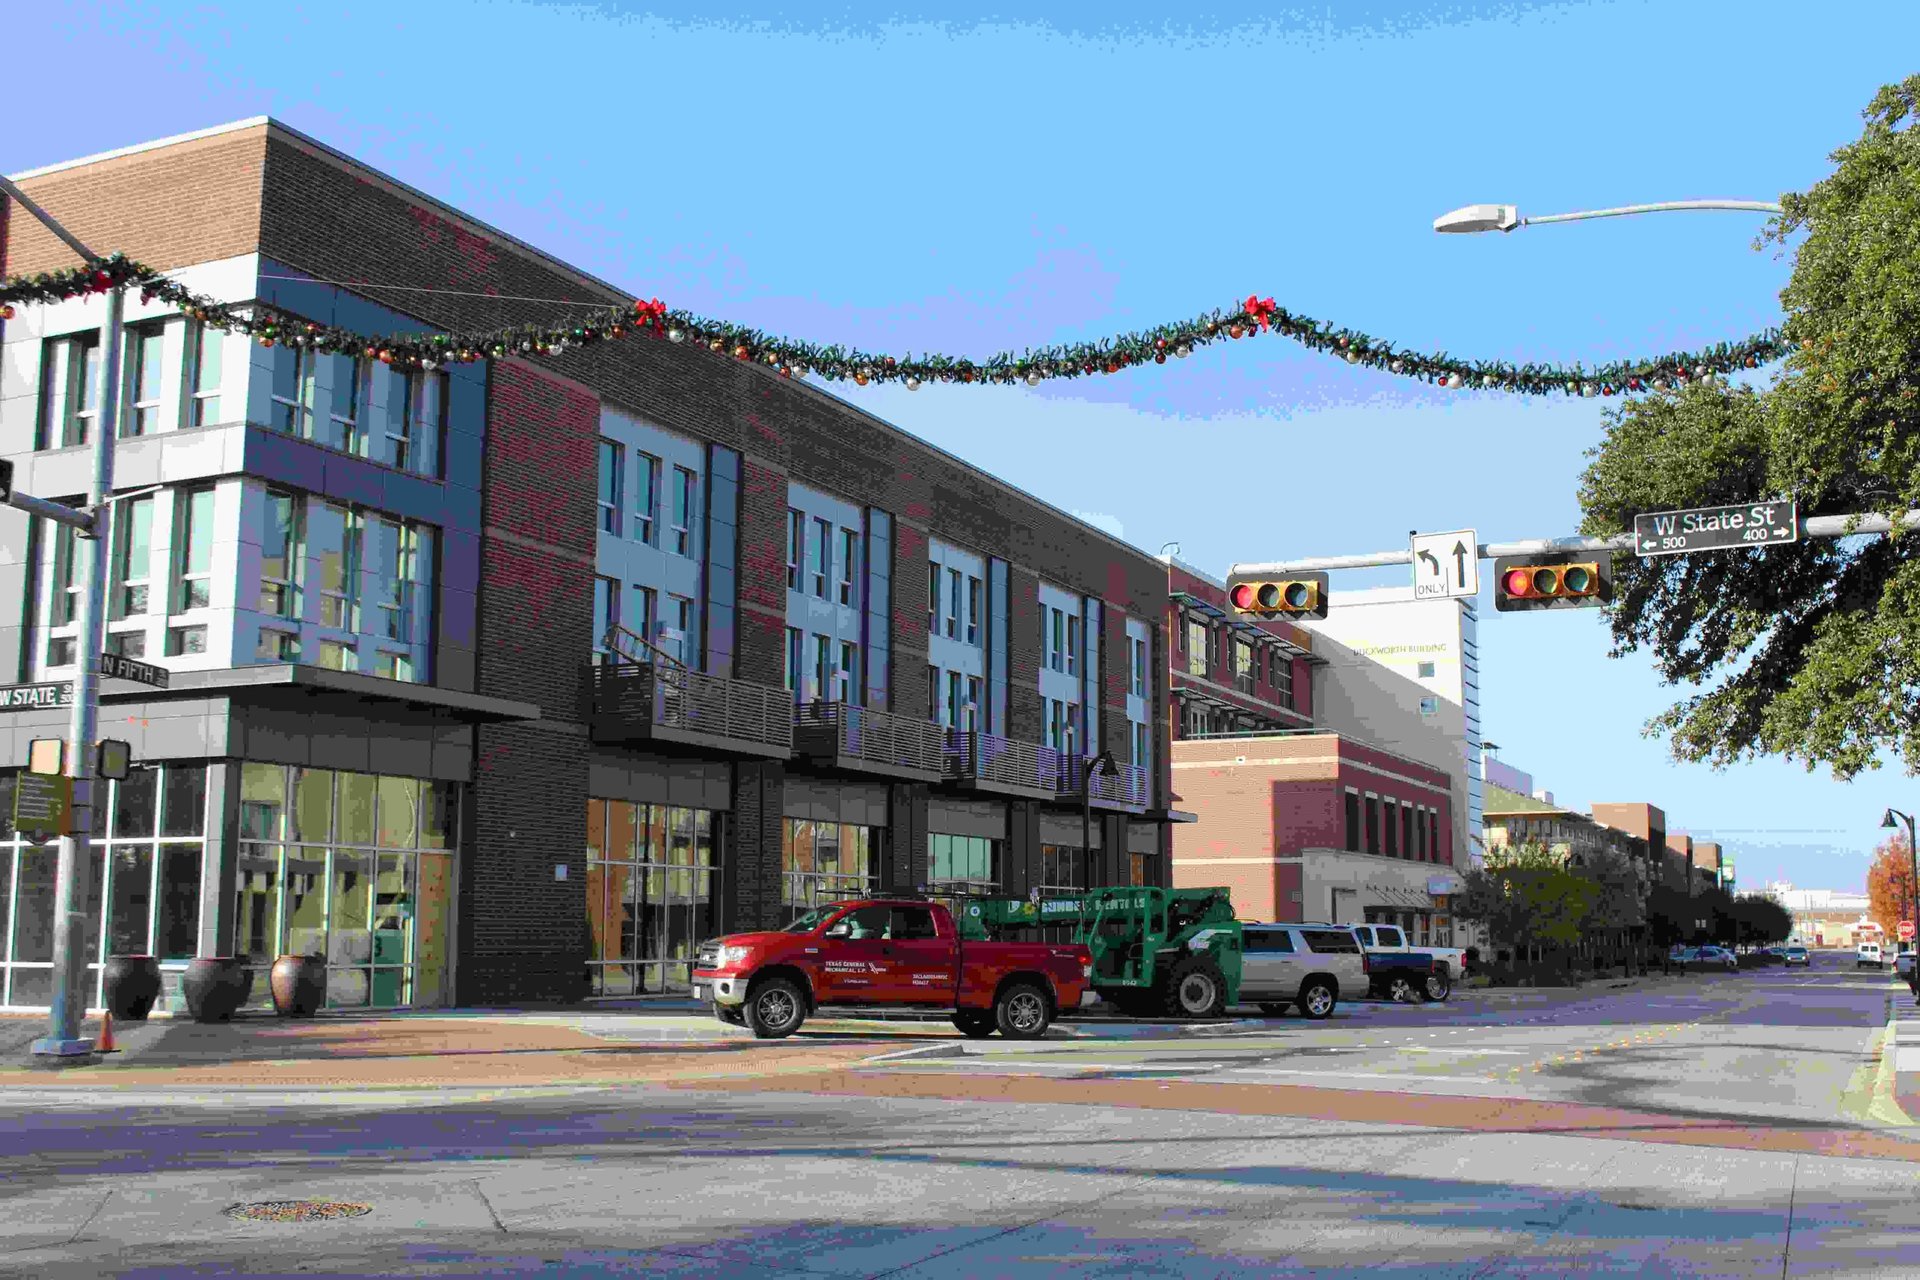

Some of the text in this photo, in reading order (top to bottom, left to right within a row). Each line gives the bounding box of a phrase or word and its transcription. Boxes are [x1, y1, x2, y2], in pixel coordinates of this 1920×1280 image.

[1653, 507, 1775, 536] W State St
[1743, 528, 1768, 541] 400
[1662, 536, 1686, 550] 500
[1417, 583, 1446, 595] ONLY
[1408, 643, 1447, 653] BUILDING
[103, 656, 114, 673] N
[118, 659, 154, 683] FIFTH
[0, 690, 12, 706] W
[13, 686, 57, 705] STATE
[1898, 925, 1914, 933] STOP
